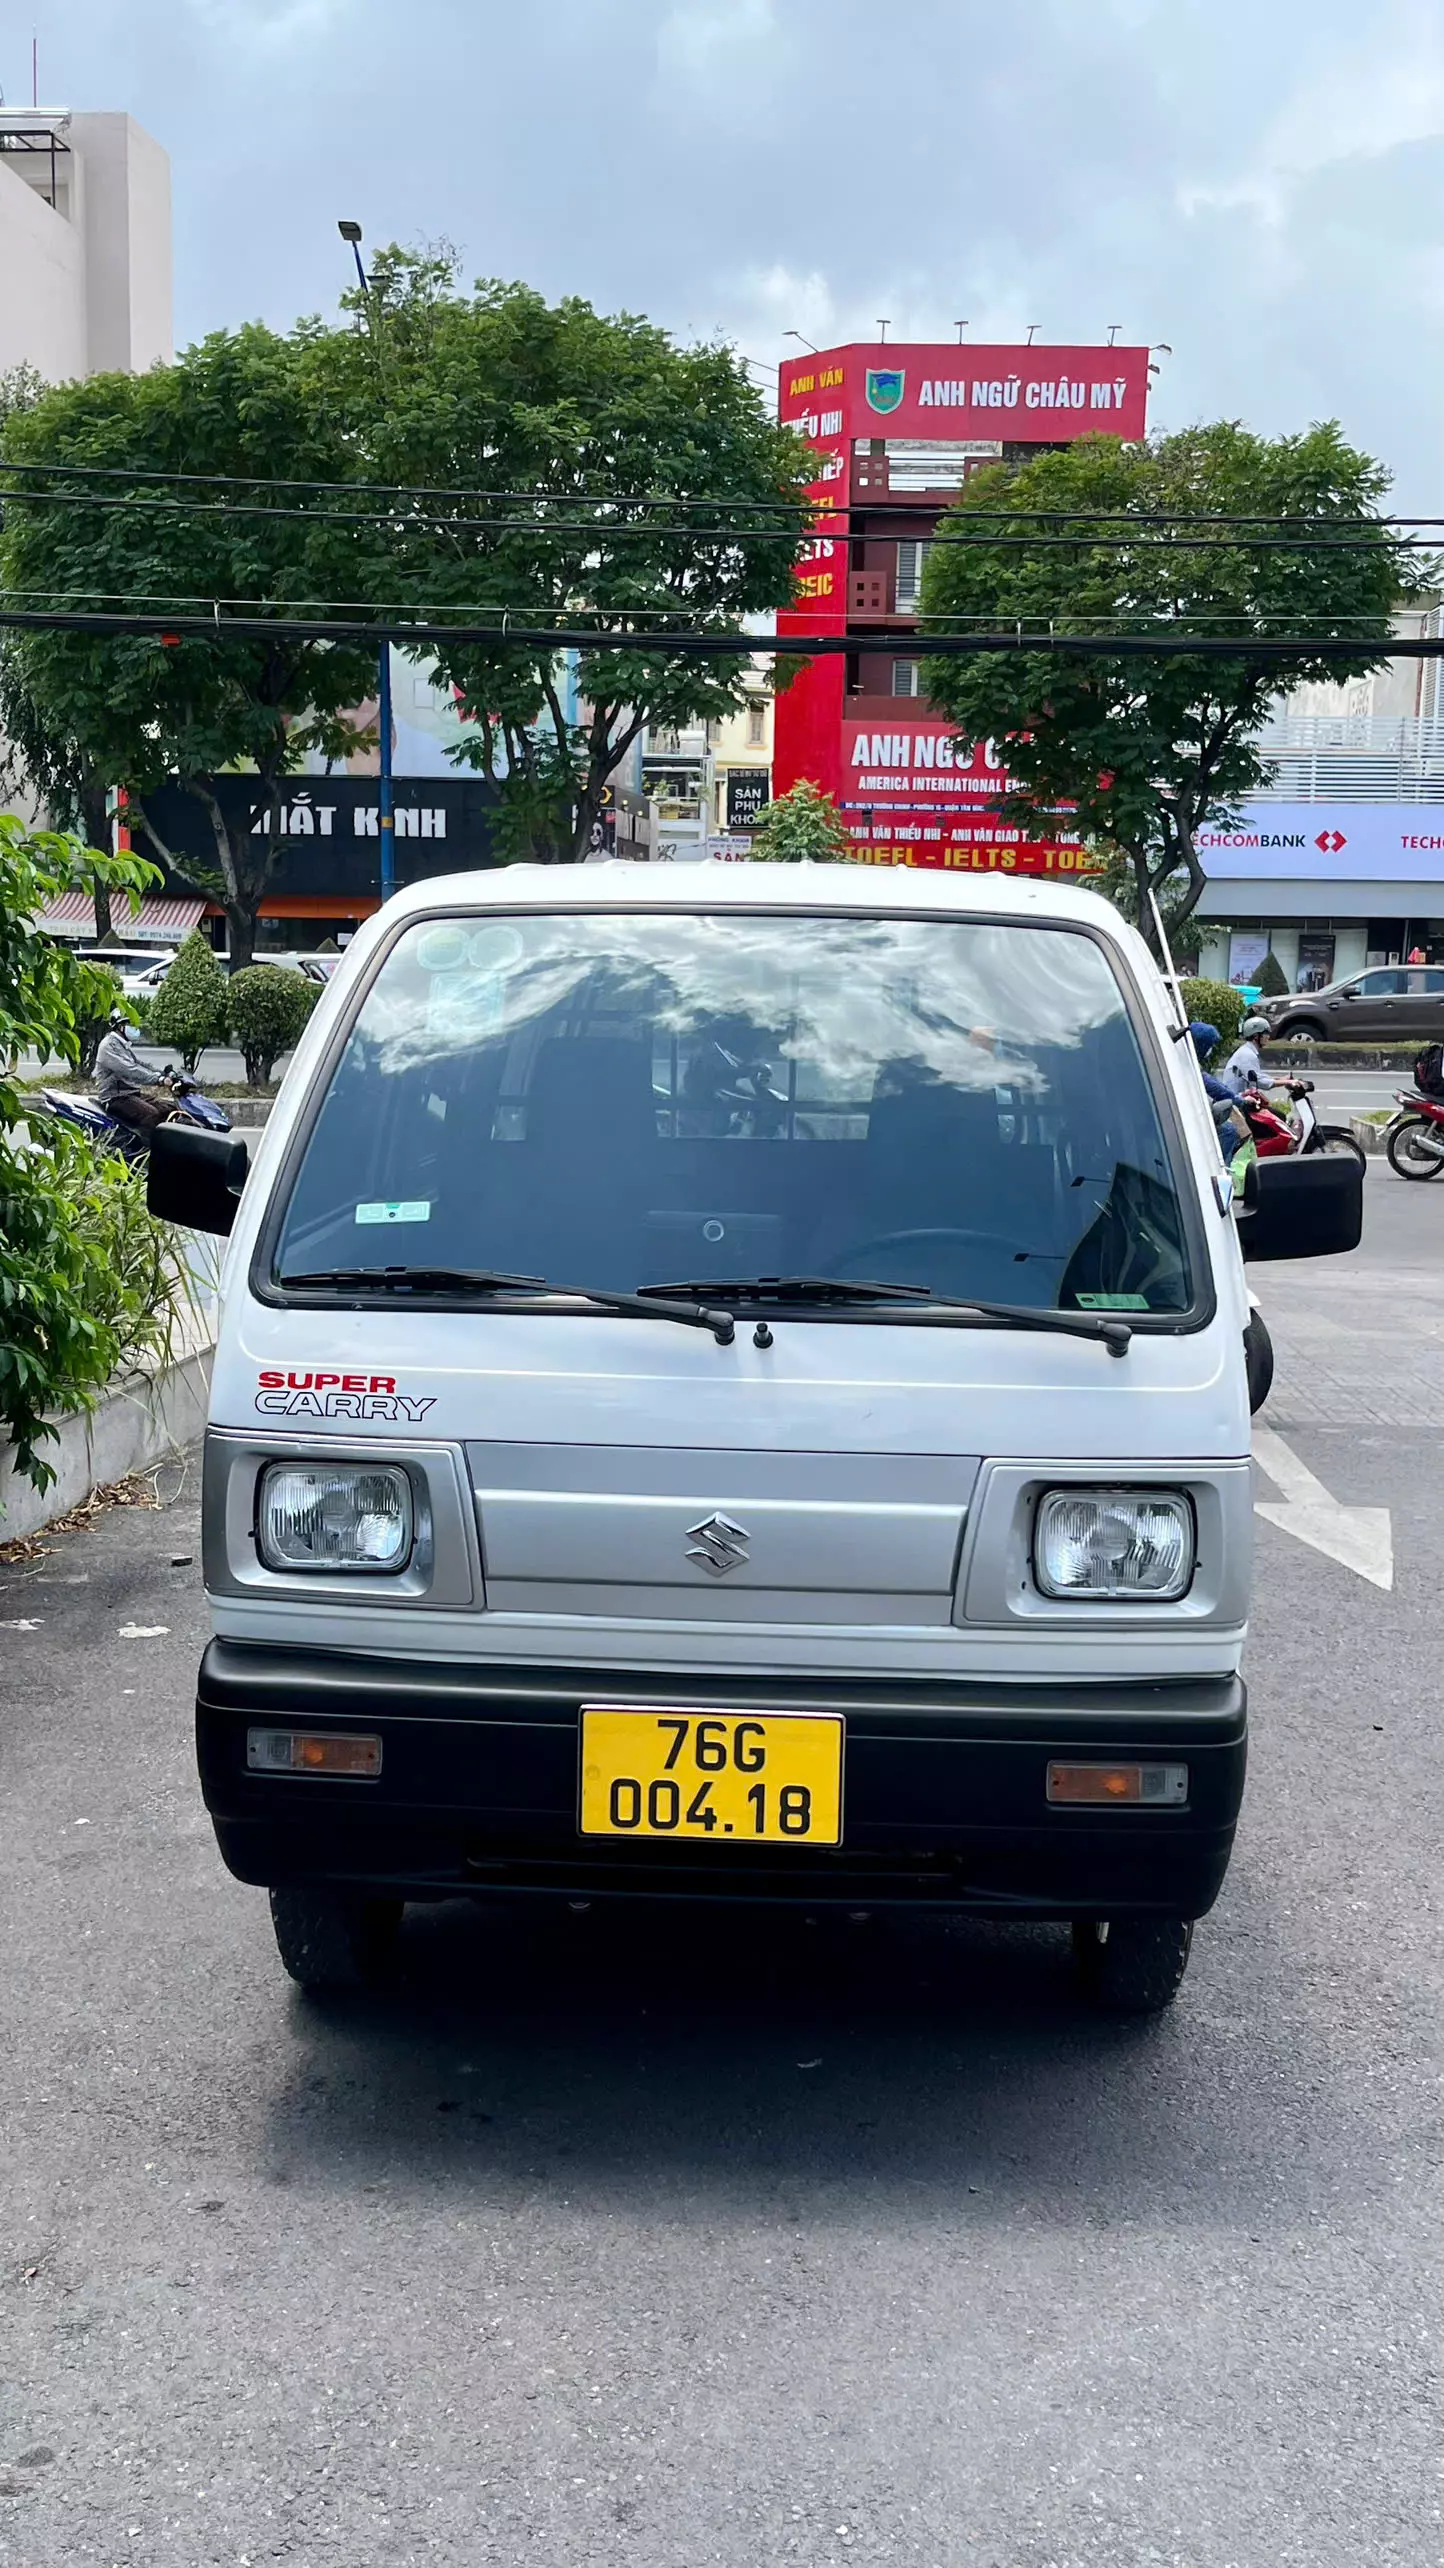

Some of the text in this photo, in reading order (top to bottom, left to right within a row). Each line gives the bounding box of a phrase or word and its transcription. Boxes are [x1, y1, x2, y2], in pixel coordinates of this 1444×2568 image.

[790, 366, 844, 396] ANH VĂN
[918, 375, 1127, 409] ANH NGỮ CHÂU MỸ
[821, 410, 842, 437] NHI
[851, 735, 910, 768] ANH
[859, 776, 910, 791] AMERICA
[912, 777, 1002, 793] INTERNATIONAL
[872, 825, 891, 839] VĂN
[894, 821, 922, 841] THIẾU
[924, 828, 941, 841] NHI
[951, 828, 972, 841] ANH
[973, 827, 993, 842] VĂN
[995, 830, 1019, 842] GIAO
[843, 846, 918, 867] TOEFL
[944, 847, 1016, 868] IELTS
[258, 1371, 396, 1393] SUPER
[255, 1390, 438, 1422] CARRY
[657, 1719, 766, 1772] 76G
[609, 1778, 811, 1835] 004.18
